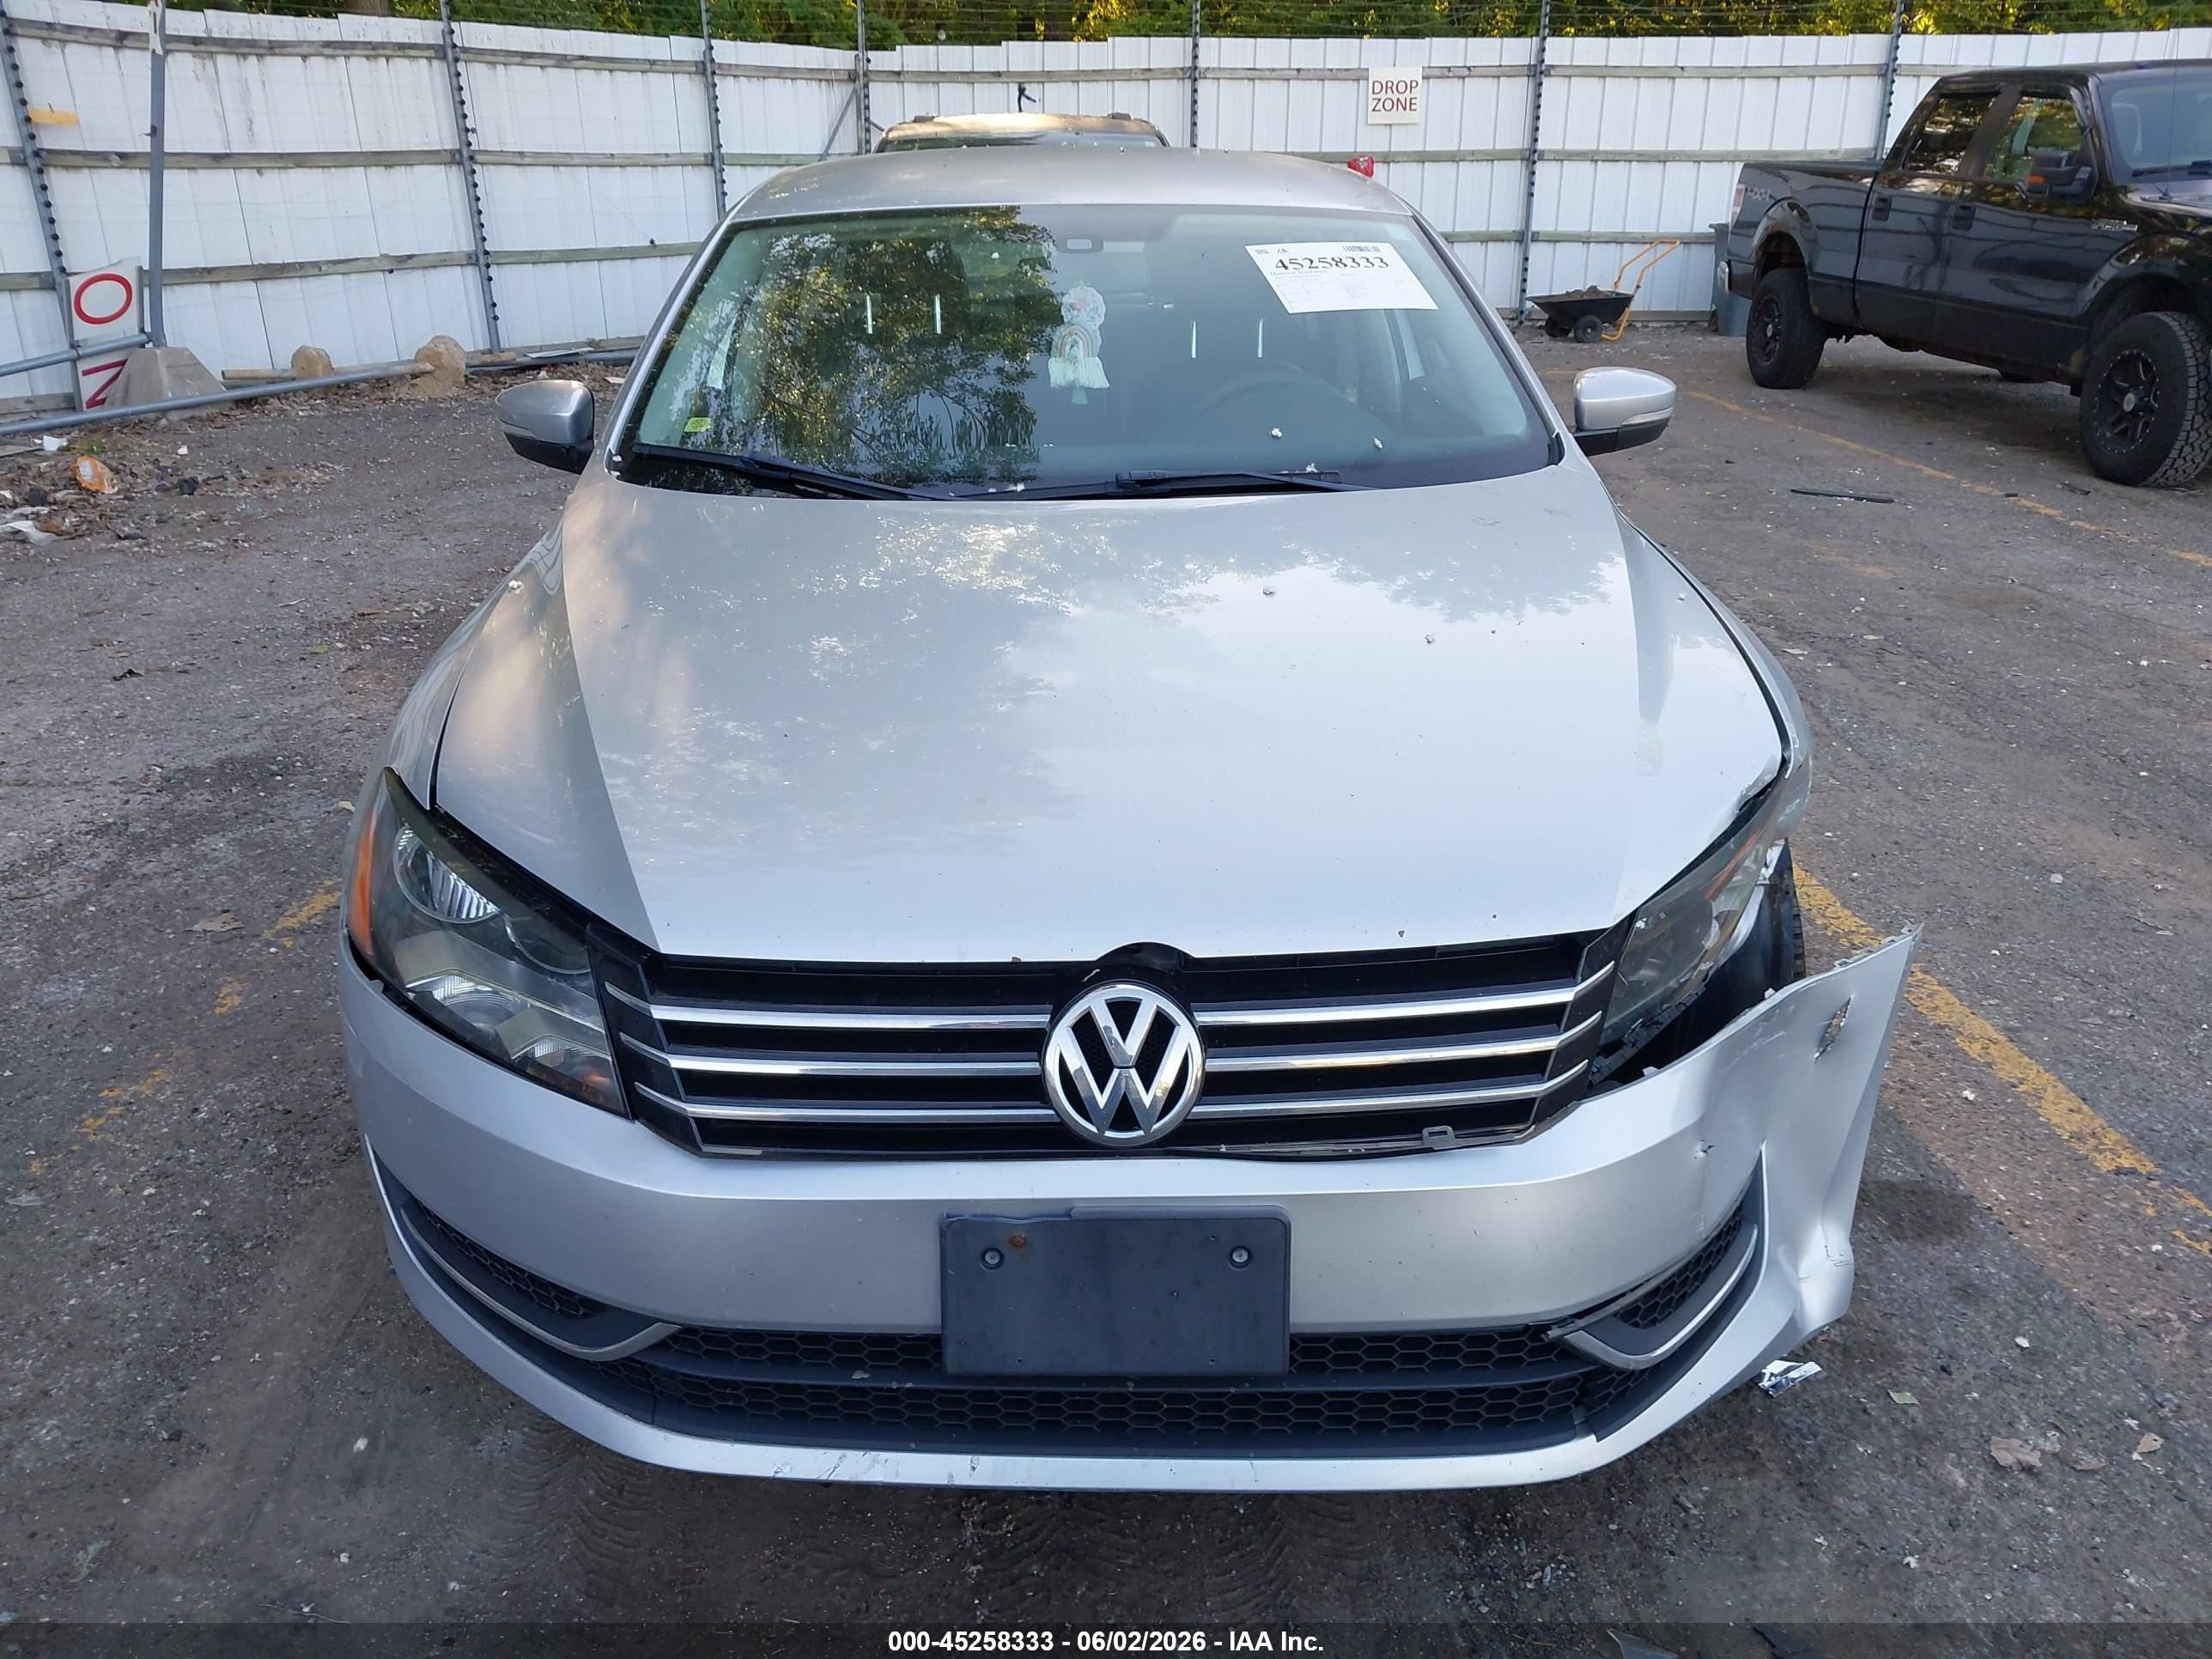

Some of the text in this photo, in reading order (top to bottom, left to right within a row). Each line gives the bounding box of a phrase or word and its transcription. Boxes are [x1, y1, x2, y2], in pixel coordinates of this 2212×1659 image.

[1371, 79, 1419, 95] DROP
[1371, 96, 1418, 112] ZONE
[1275, 256, 1389, 270] 45258333
